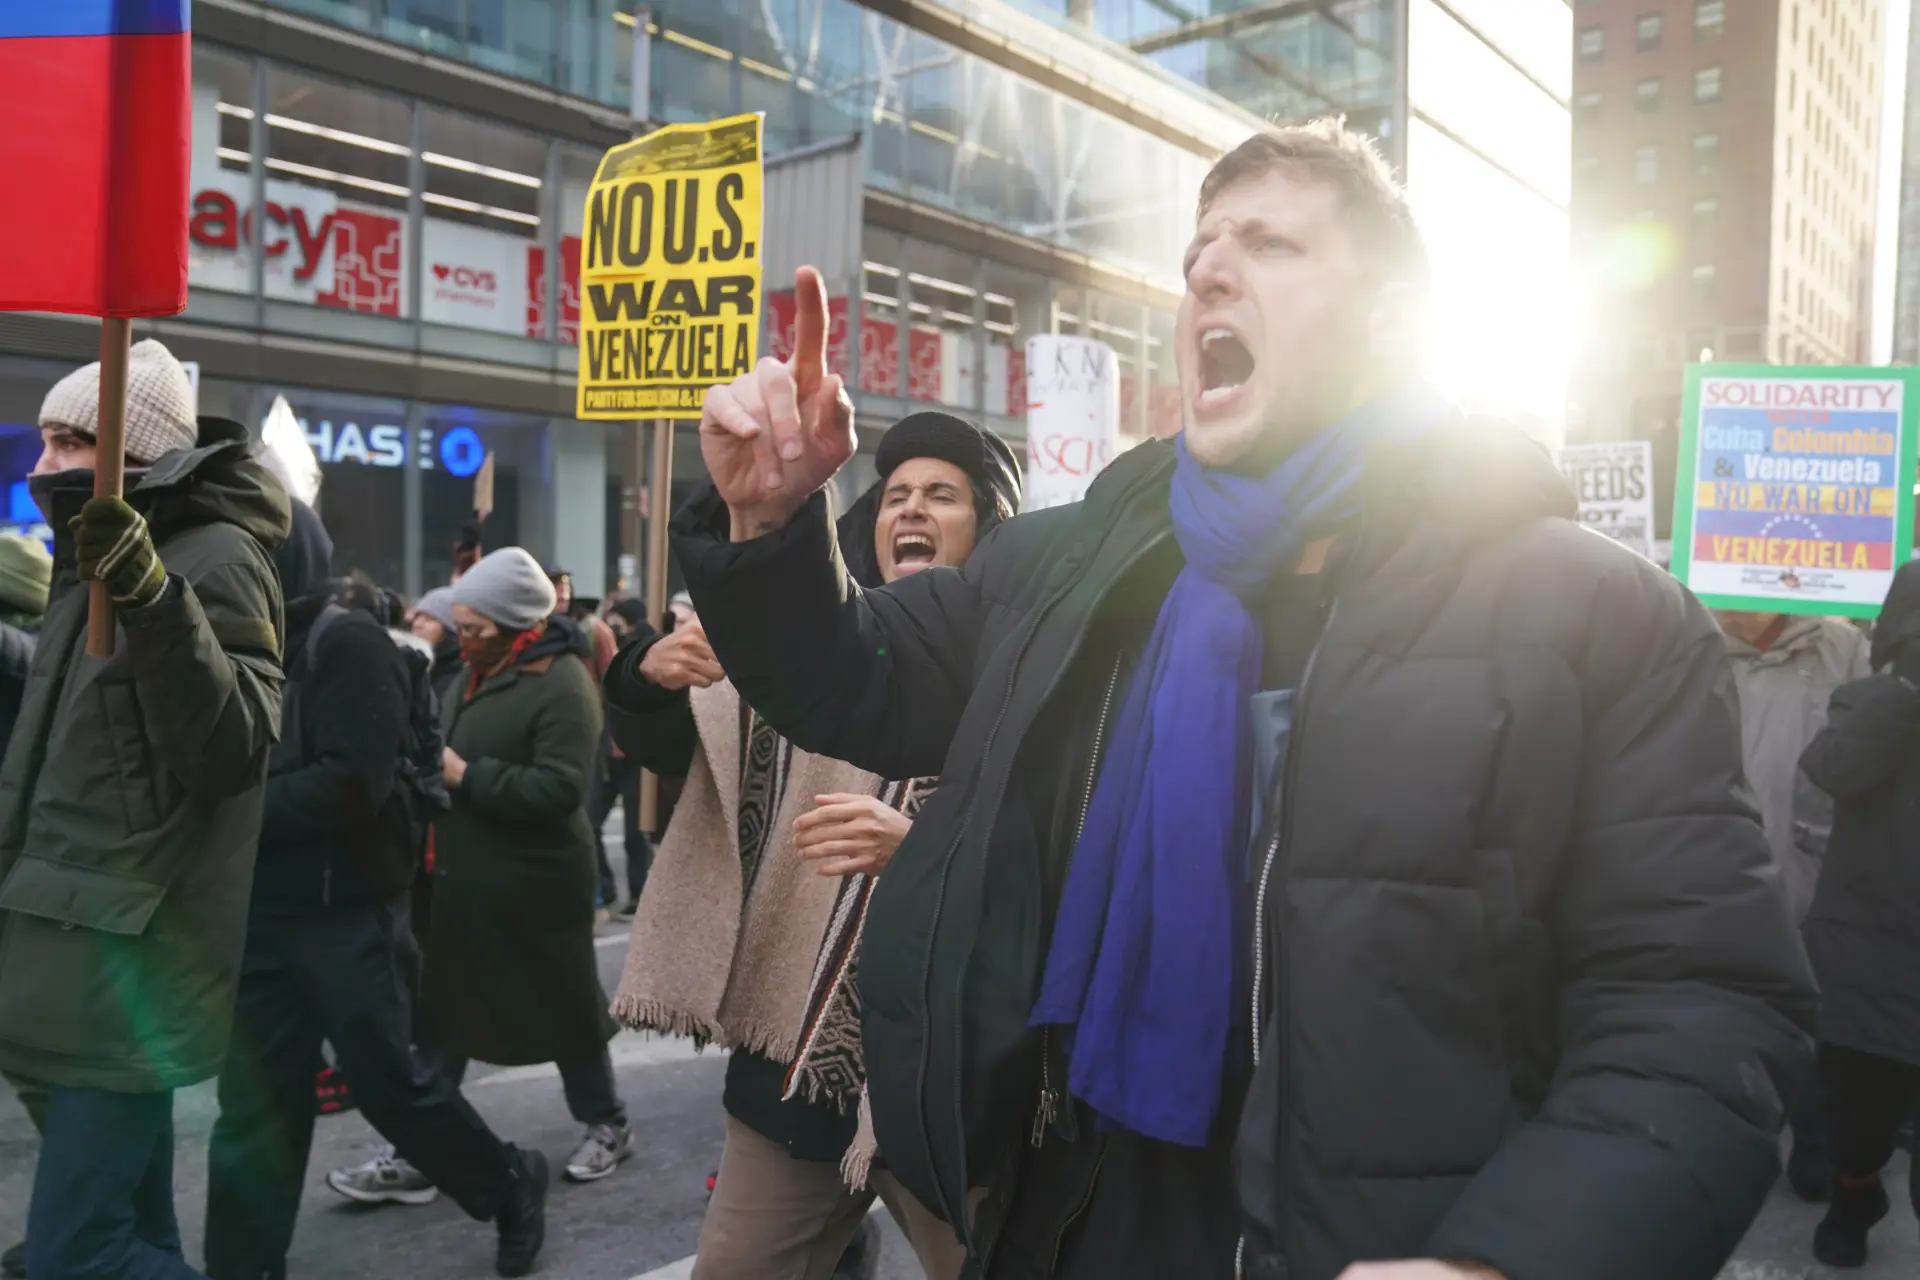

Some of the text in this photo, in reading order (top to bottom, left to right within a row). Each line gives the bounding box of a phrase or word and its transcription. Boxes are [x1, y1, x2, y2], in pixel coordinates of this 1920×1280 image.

[588, 173, 756, 269] NO U.S.
[588, 275, 756, 322] WAR
[651, 313, 681, 326] ON
[587, 322, 750, 380] VENEZUELA
[1706, 382, 1896, 409] SOLIDARITY
[264, 417, 434, 469] HASE
[1772, 427, 1895, 456] Colombia
[1713, 452, 1881, 483] & Venezuela
[1714, 482, 1872, 513] NO WAR ON
[1713, 535, 1868, 570] VENEZUELA
